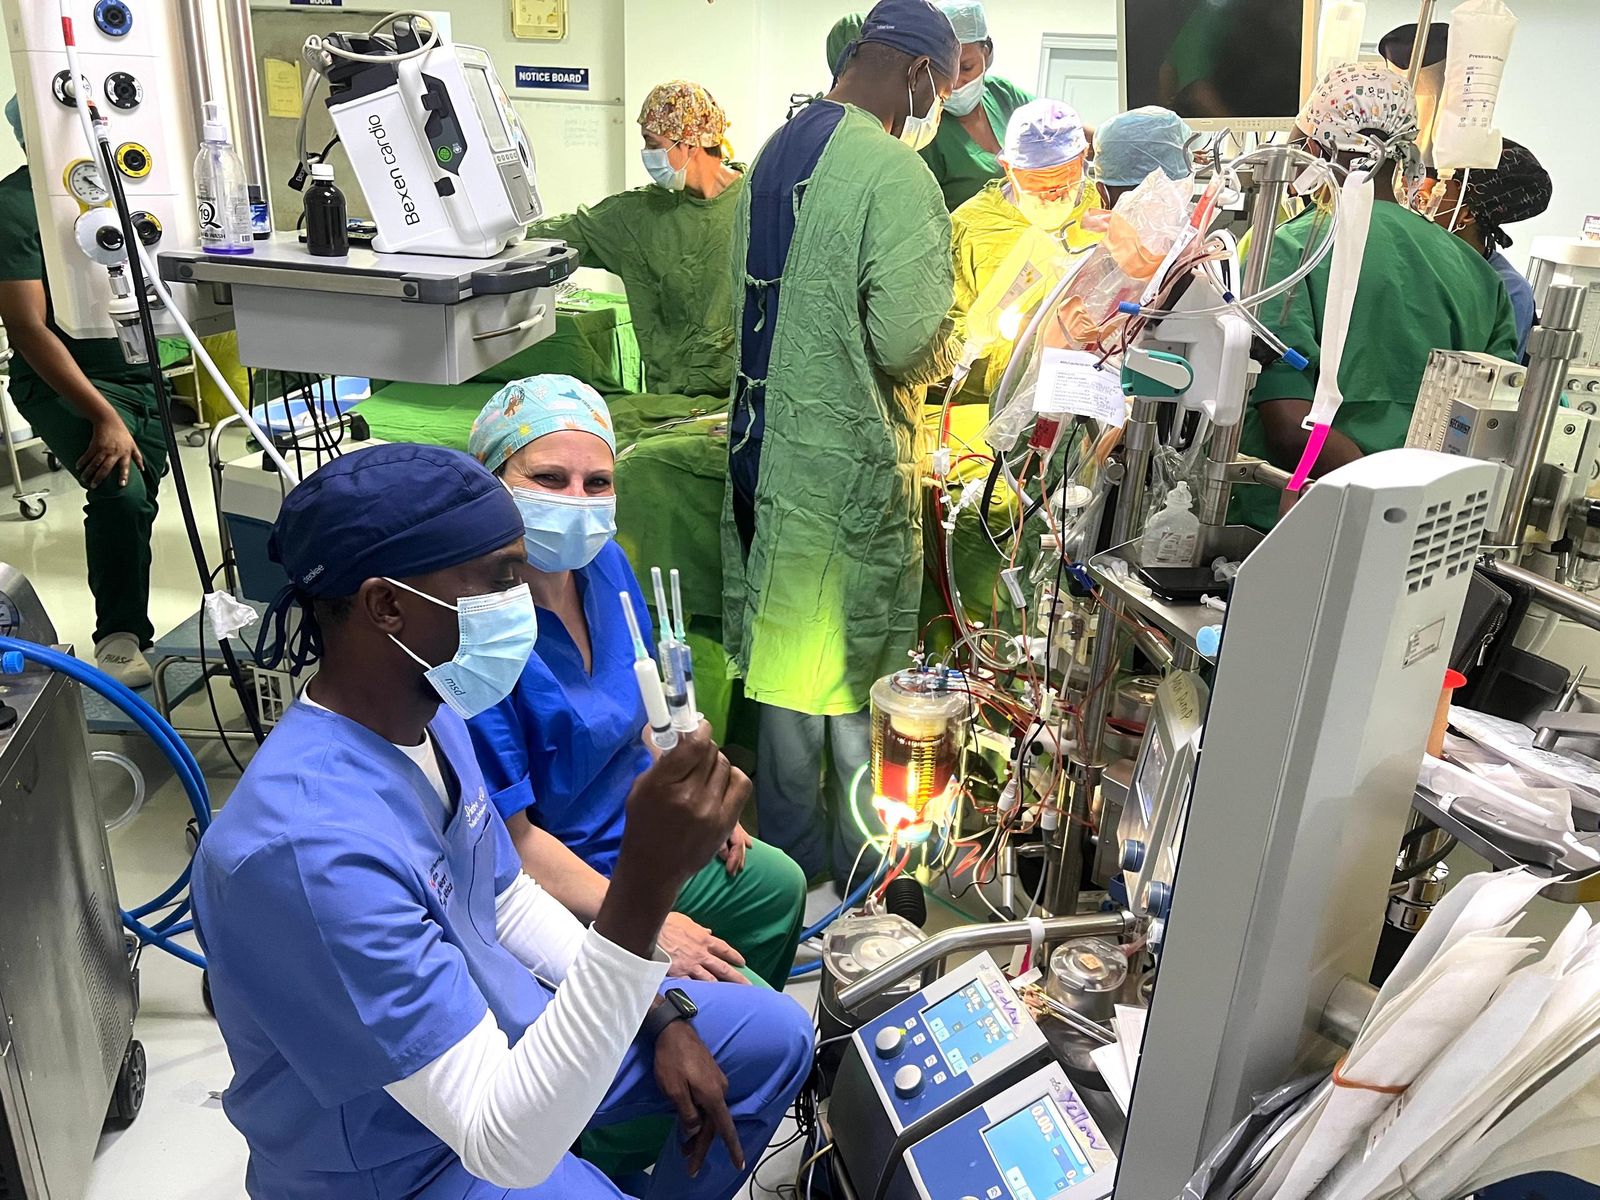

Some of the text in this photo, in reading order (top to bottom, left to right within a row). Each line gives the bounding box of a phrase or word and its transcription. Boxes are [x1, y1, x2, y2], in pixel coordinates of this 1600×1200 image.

[519, 72, 582, 83] NOTICE BOARD
[368, 114, 420, 226] Bexen cardio
[445, 678, 467, 696] msd
